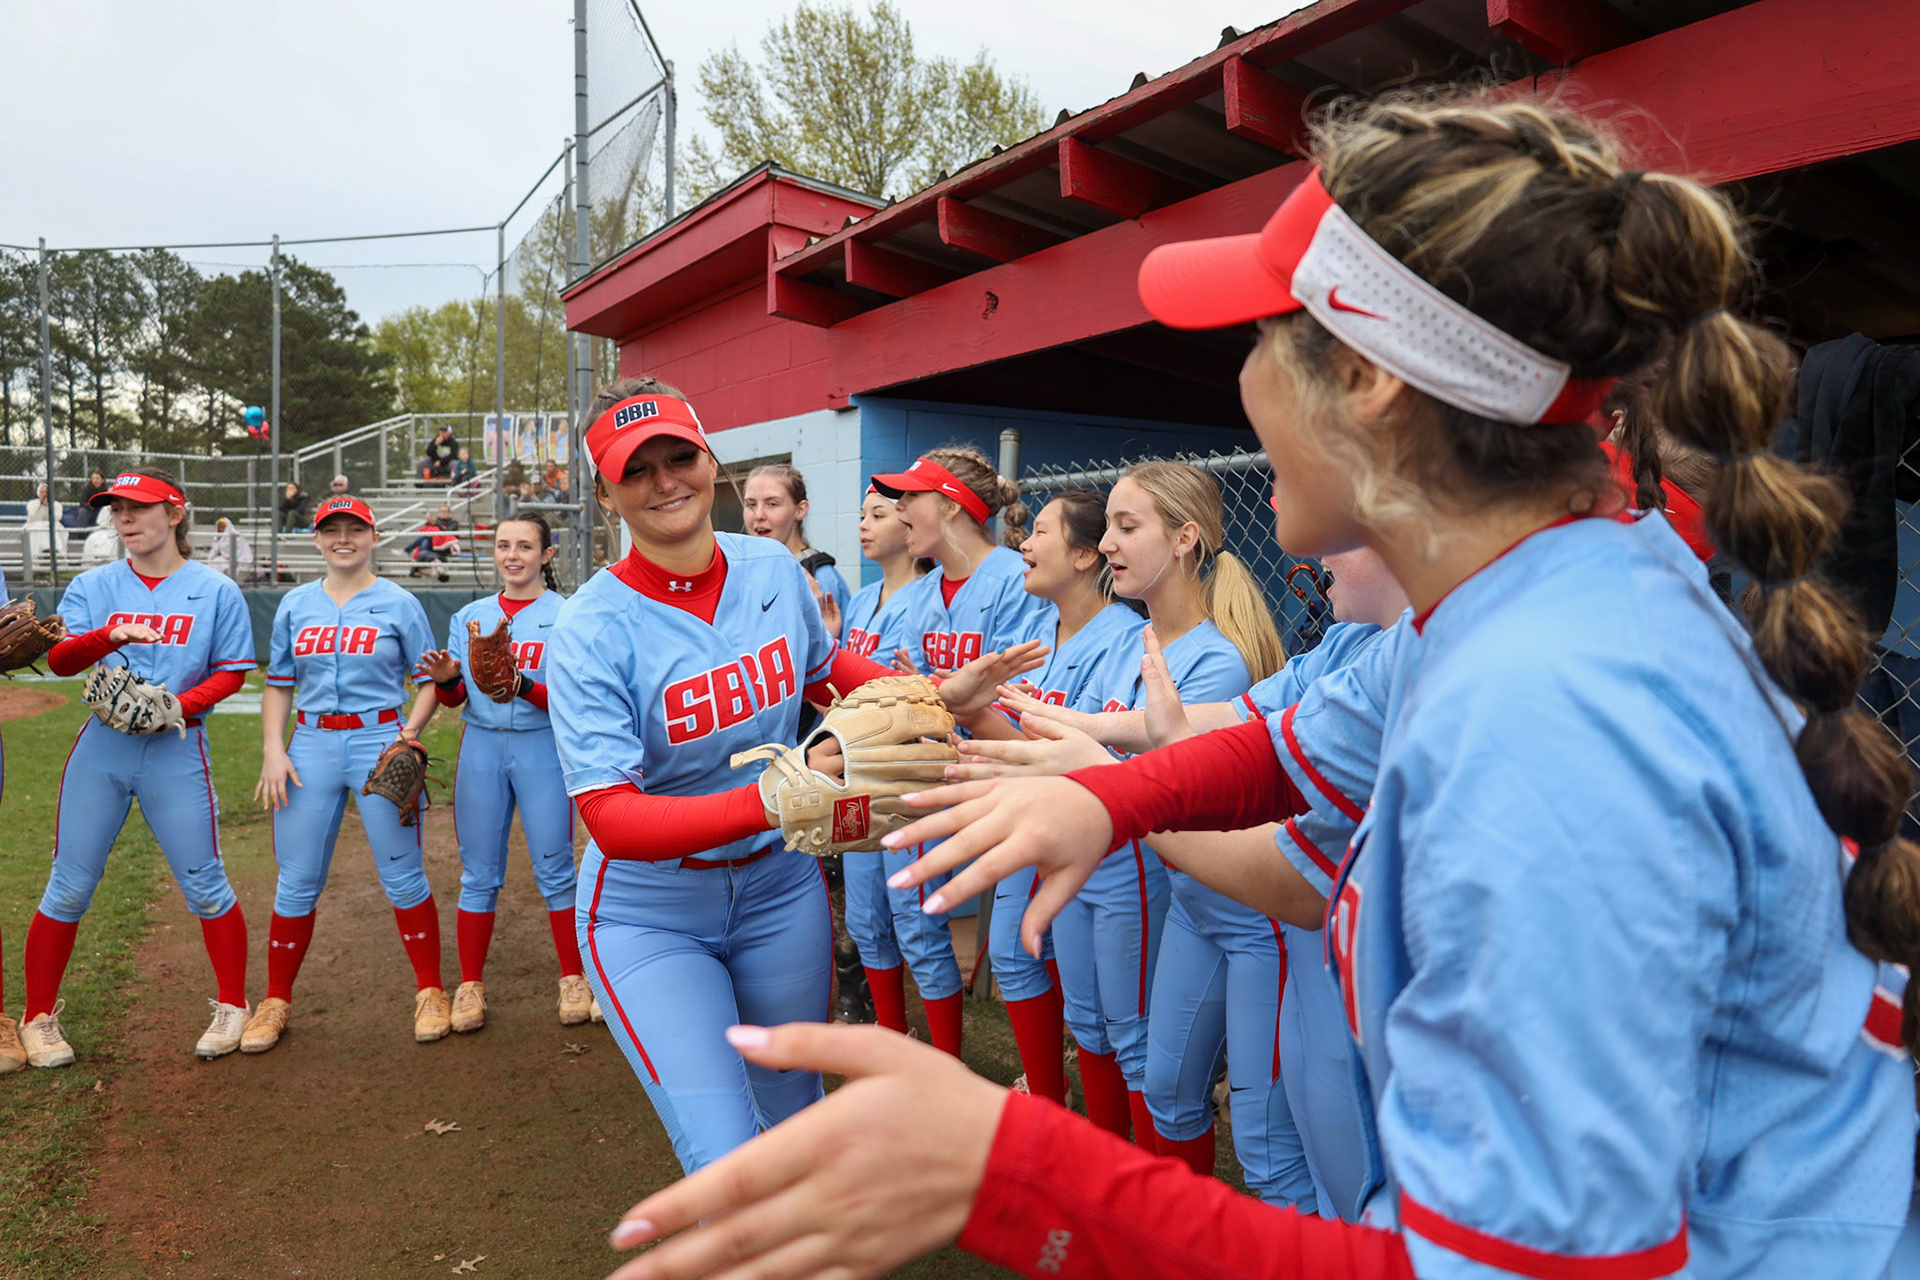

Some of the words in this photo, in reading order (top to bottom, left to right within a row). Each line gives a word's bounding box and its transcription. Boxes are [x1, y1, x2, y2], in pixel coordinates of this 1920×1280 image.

[115, 476, 141, 487] SBA
[295, 625, 380, 657] SBA
[922, 630, 984, 673] SBA
[662, 634, 796, 746] SBA
